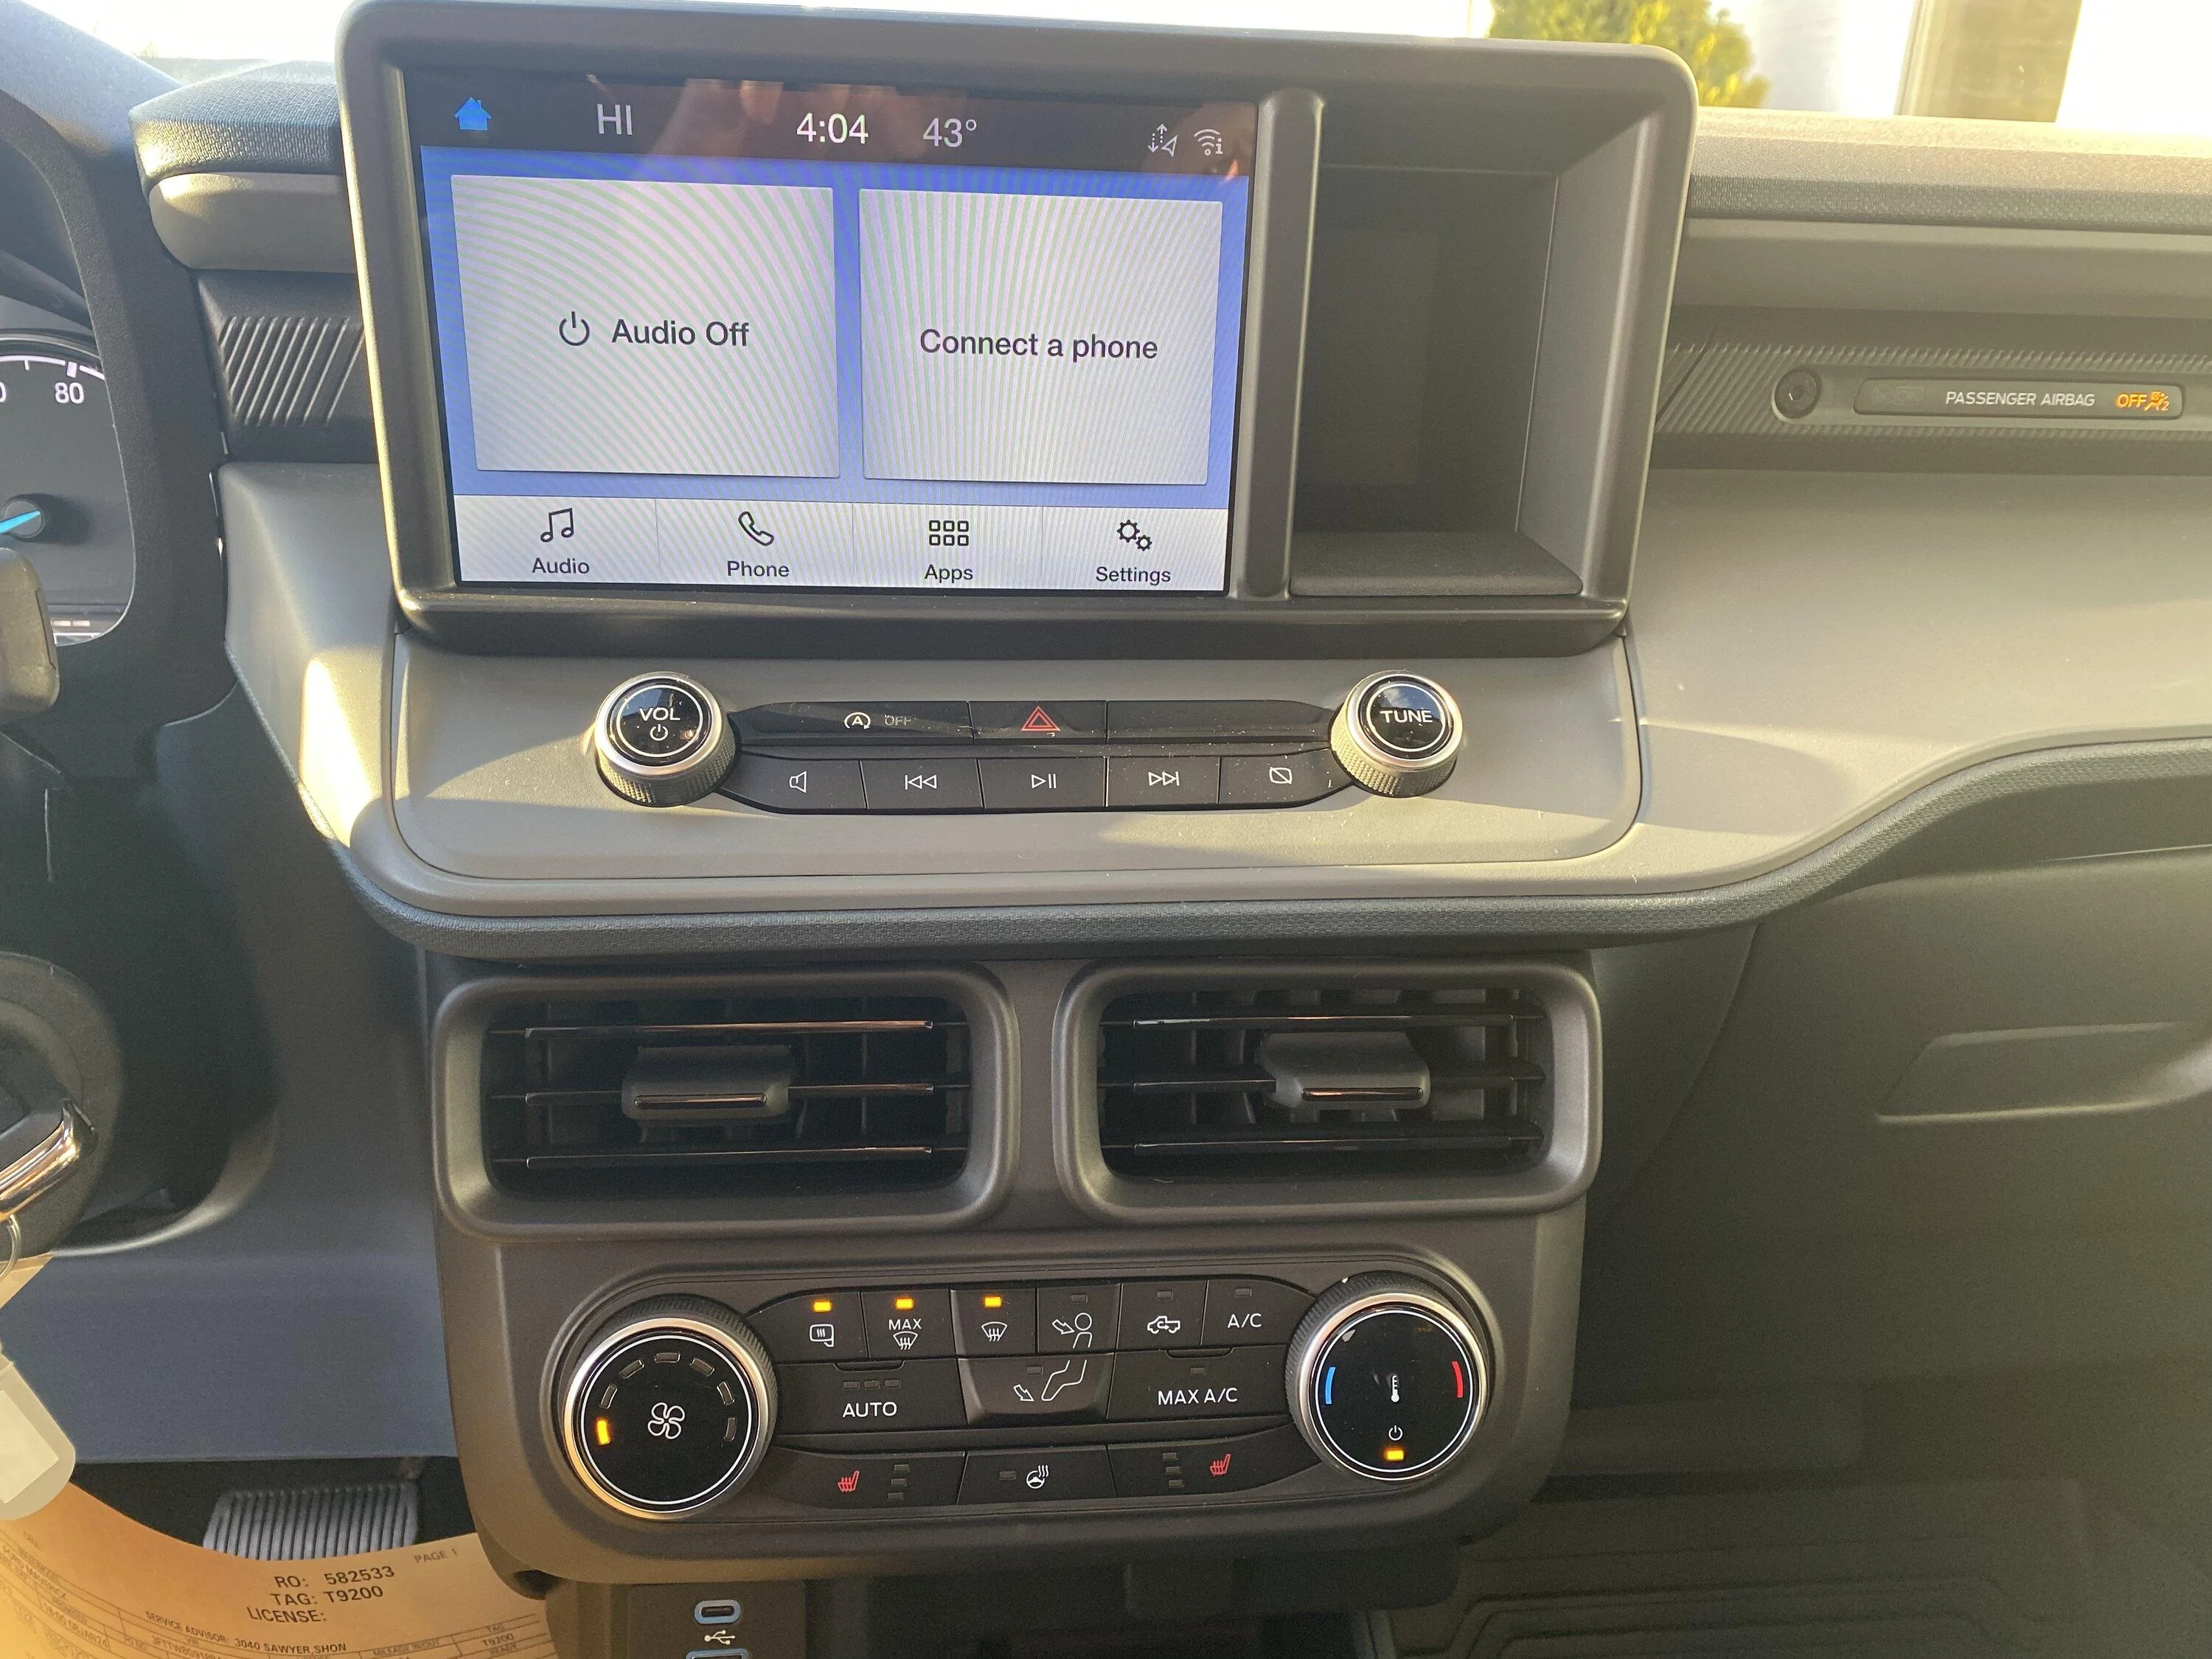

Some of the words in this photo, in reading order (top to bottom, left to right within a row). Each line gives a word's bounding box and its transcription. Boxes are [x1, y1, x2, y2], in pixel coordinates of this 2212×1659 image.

[596, 105, 633, 135] HI
[796, 112, 869, 145] 4:04
[922, 118, 978, 147] 43°
[611, 318, 697, 346] Audio
[705, 320, 750, 347] Off
[919, 329, 1038, 355] Connect
[1047, 339, 1064, 357] a
[1071, 335, 1158, 364] phone
[55, 382, 85, 404] 80
[1946, 392, 2037, 406] PASSENGER
[2040, 394, 2096, 406] AIRBAG
[2116, 393, 2147, 408] OFF
[532, 558, 591, 574] Audio
[726, 562, 790, 577] Phone
[924, 565, 973, 585] Apps
[1095, 567, 1171, 586] Settings
[639, 708, 681, 722] VOL
[885, 715, 911, 726] OFF
[1380, 710, 1433, 724] TUNE
[888, 1318, 922, 1330] MAX
[1227, 1313, 1262, 1329] A/C
[1158, 1390, 1200, 1405] MAX
[1204, 1388, 1238, 1405] A/C
[842, 1402, 897, 1418] AUTO
[414, 1551, 447, 1564] PAGE
[274, 1575, 308, 1588] RO:
[324, 1565, 395, 1585] 582533
[269, 1593, 318, 1606] TAG:
[323, 1585, 383, 1604] T9200
[246, 1606, 327, 1623] LICENSE:
[145, 1610, 182, 1631] SERVICE
[234, 1638, 260, 1651] 3040
